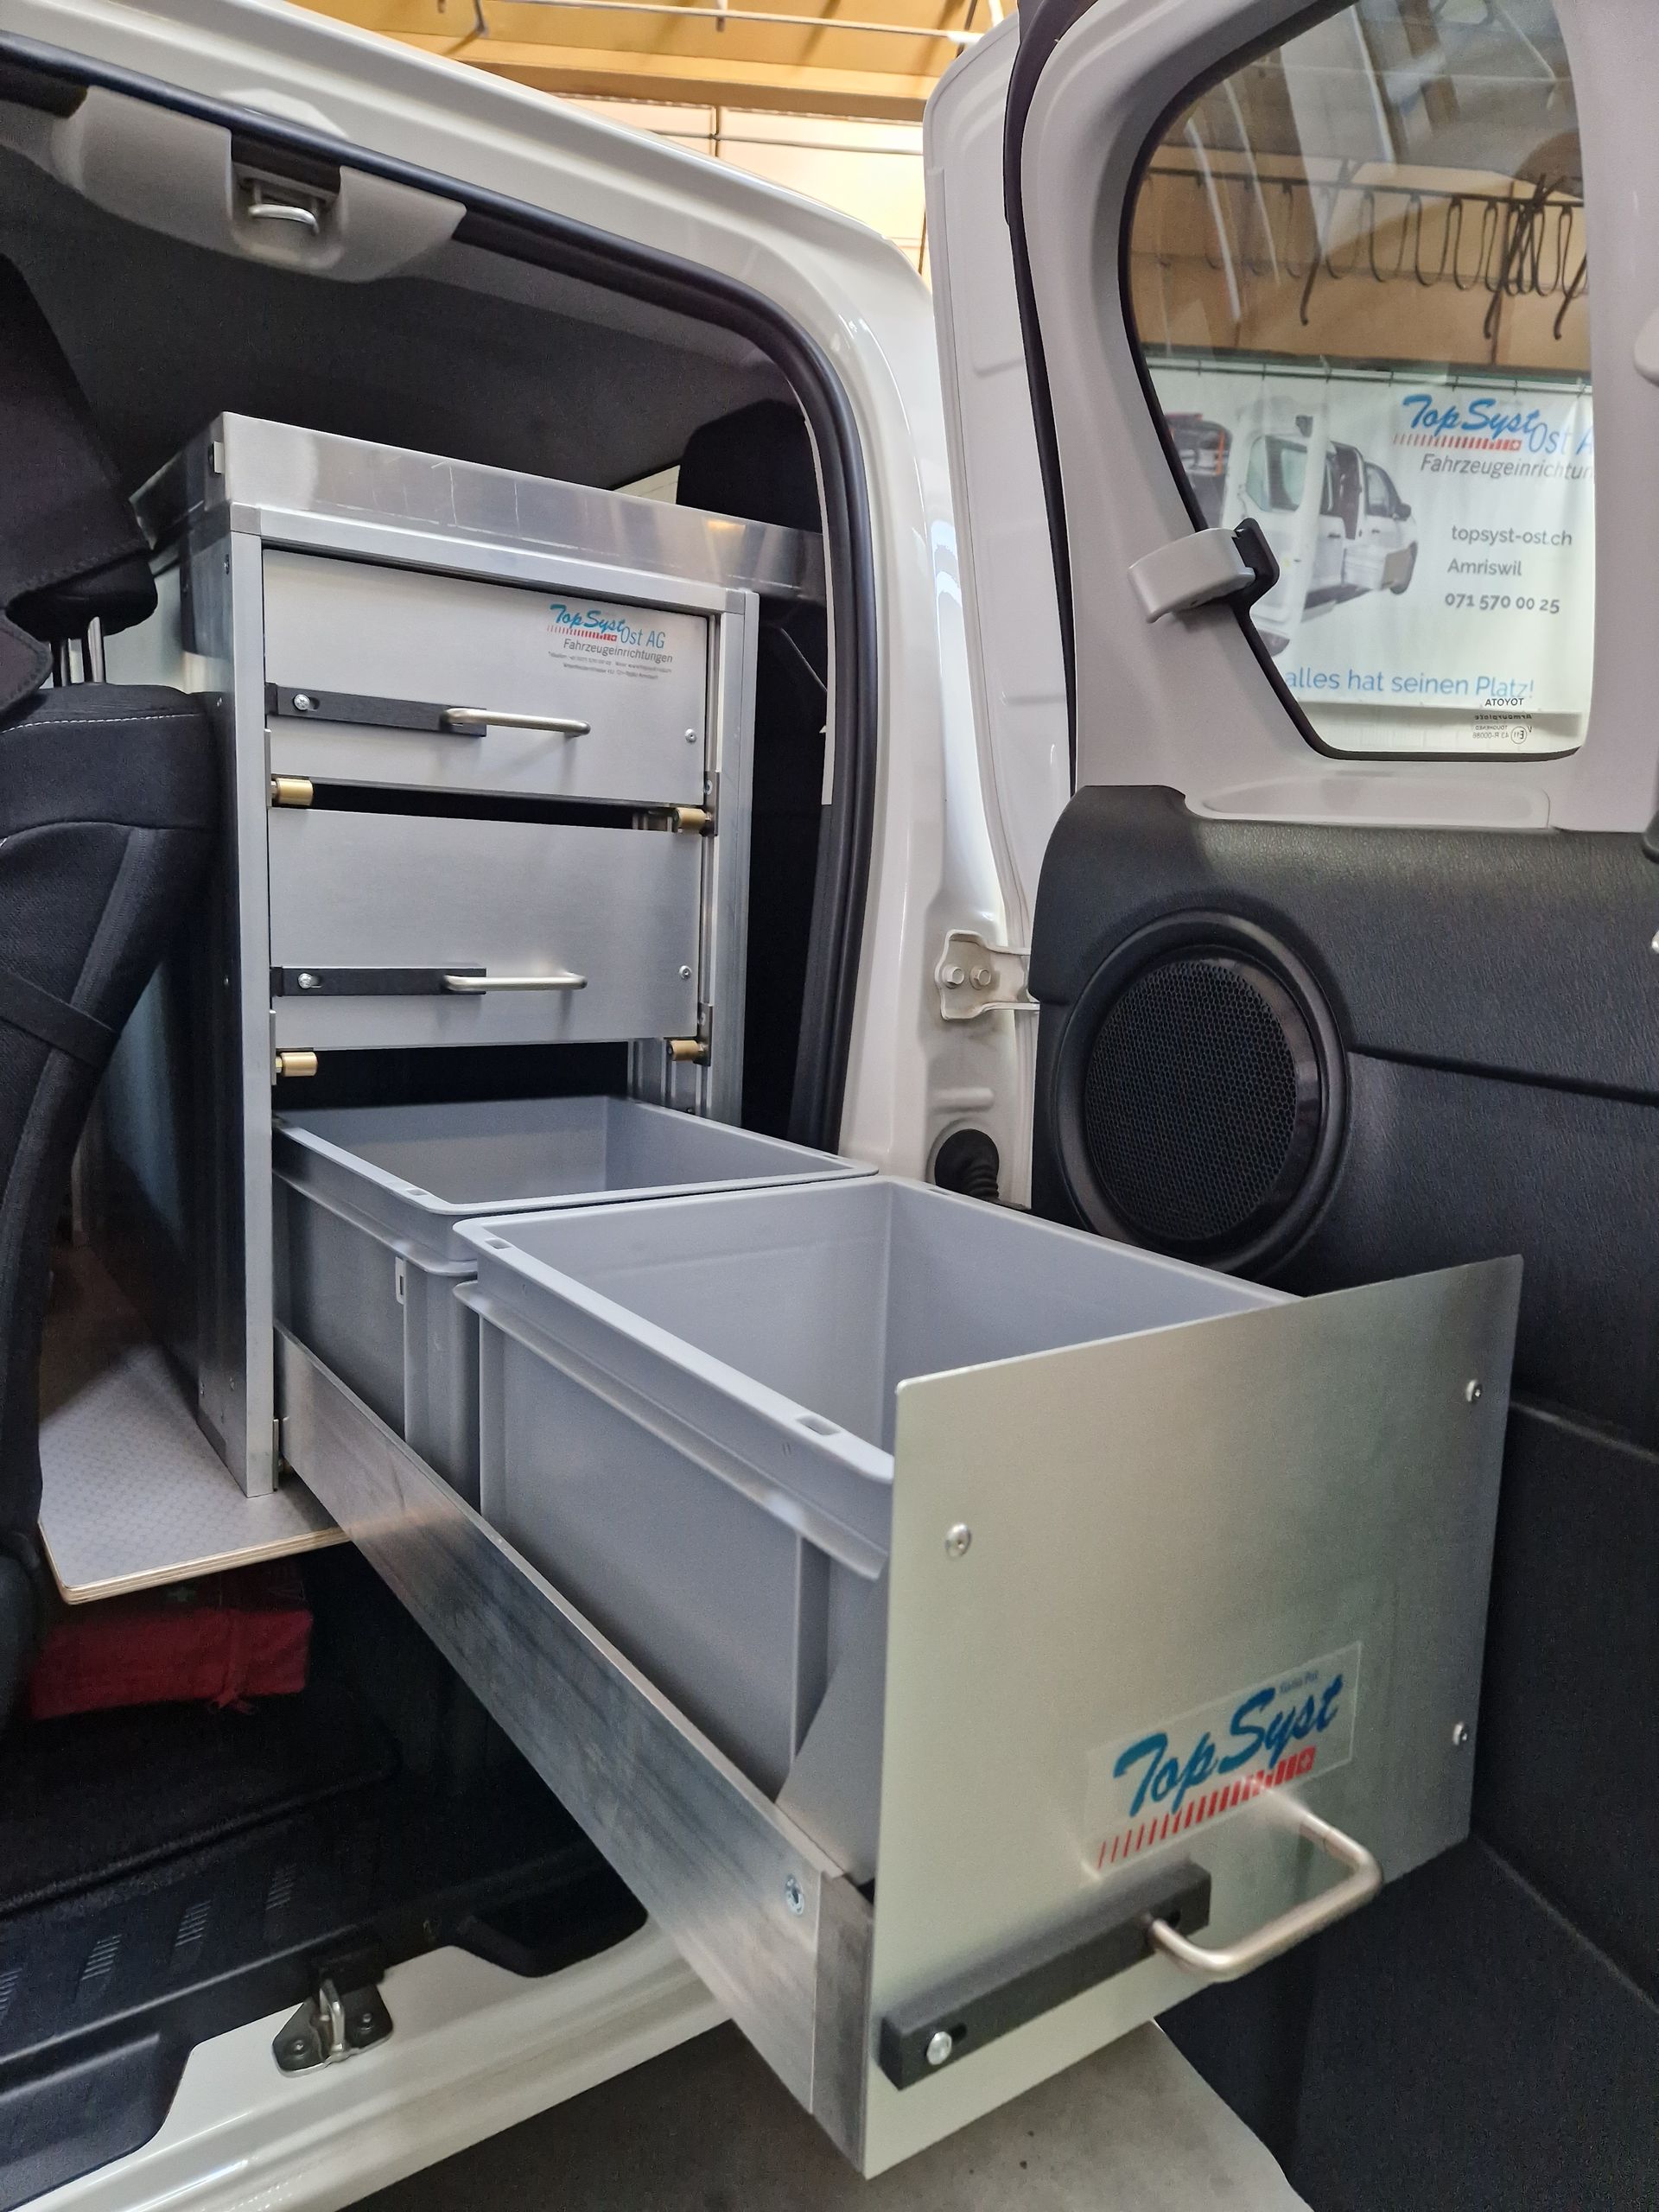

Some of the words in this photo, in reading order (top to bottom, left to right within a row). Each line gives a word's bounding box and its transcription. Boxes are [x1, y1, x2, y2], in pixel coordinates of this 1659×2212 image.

[1529, 423, 1571, 454] Ost
[1452, 524, 1573, 546] topsyst-ost.ch
[1447, 558, 1522, 576] Amriswil
[1445, 594, 1475, 608] 071
[1479, 594, 1511, 611] 570
[1516, 597, 1536, 611] 00
[1541, 599, 1560, 613] 25
[620, 626, 643, 646] Ost
[646, 631, 666, 649] AG
[563, 639, 673, 664] Fahrzeugeinrichtungen
[1285, 667, 1341, 689] alles
[1348, 669, 1384, 692] hat
[1391, 671, 1469, 695] seinen
[1477, 676, 1534, 697] Platz!
